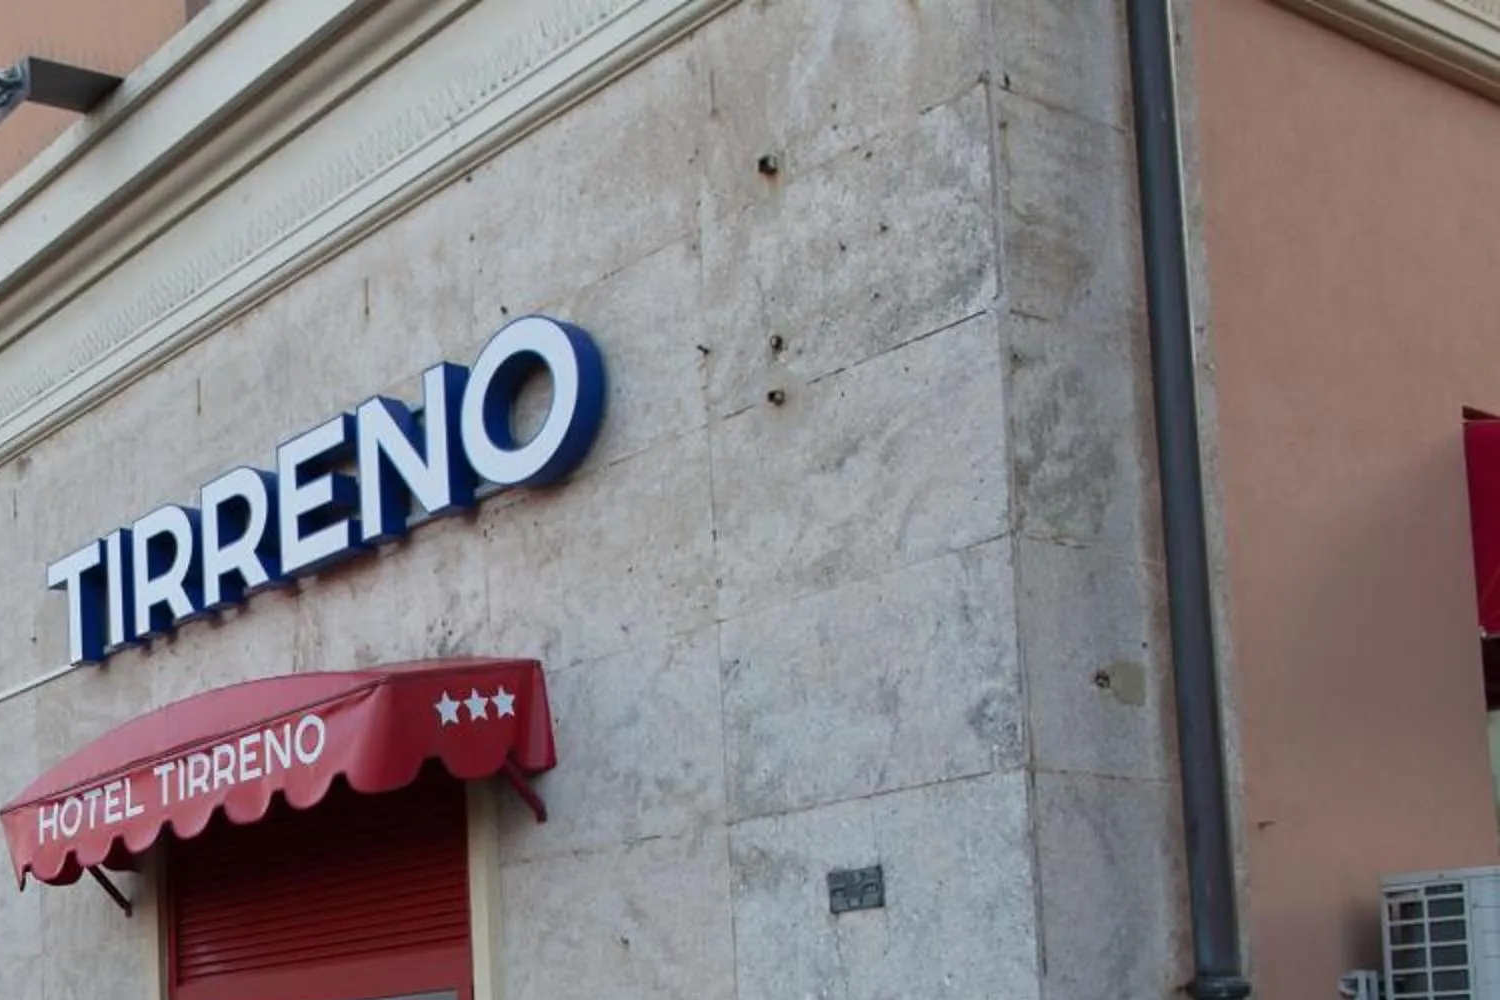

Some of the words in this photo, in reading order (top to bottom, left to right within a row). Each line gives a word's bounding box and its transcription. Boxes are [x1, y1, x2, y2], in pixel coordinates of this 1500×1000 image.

[46, 315, 604, 666] TIRRENO
[37, 778, 145, 845] HOTEL
[153, 714, 326, 807] TIRRENO
